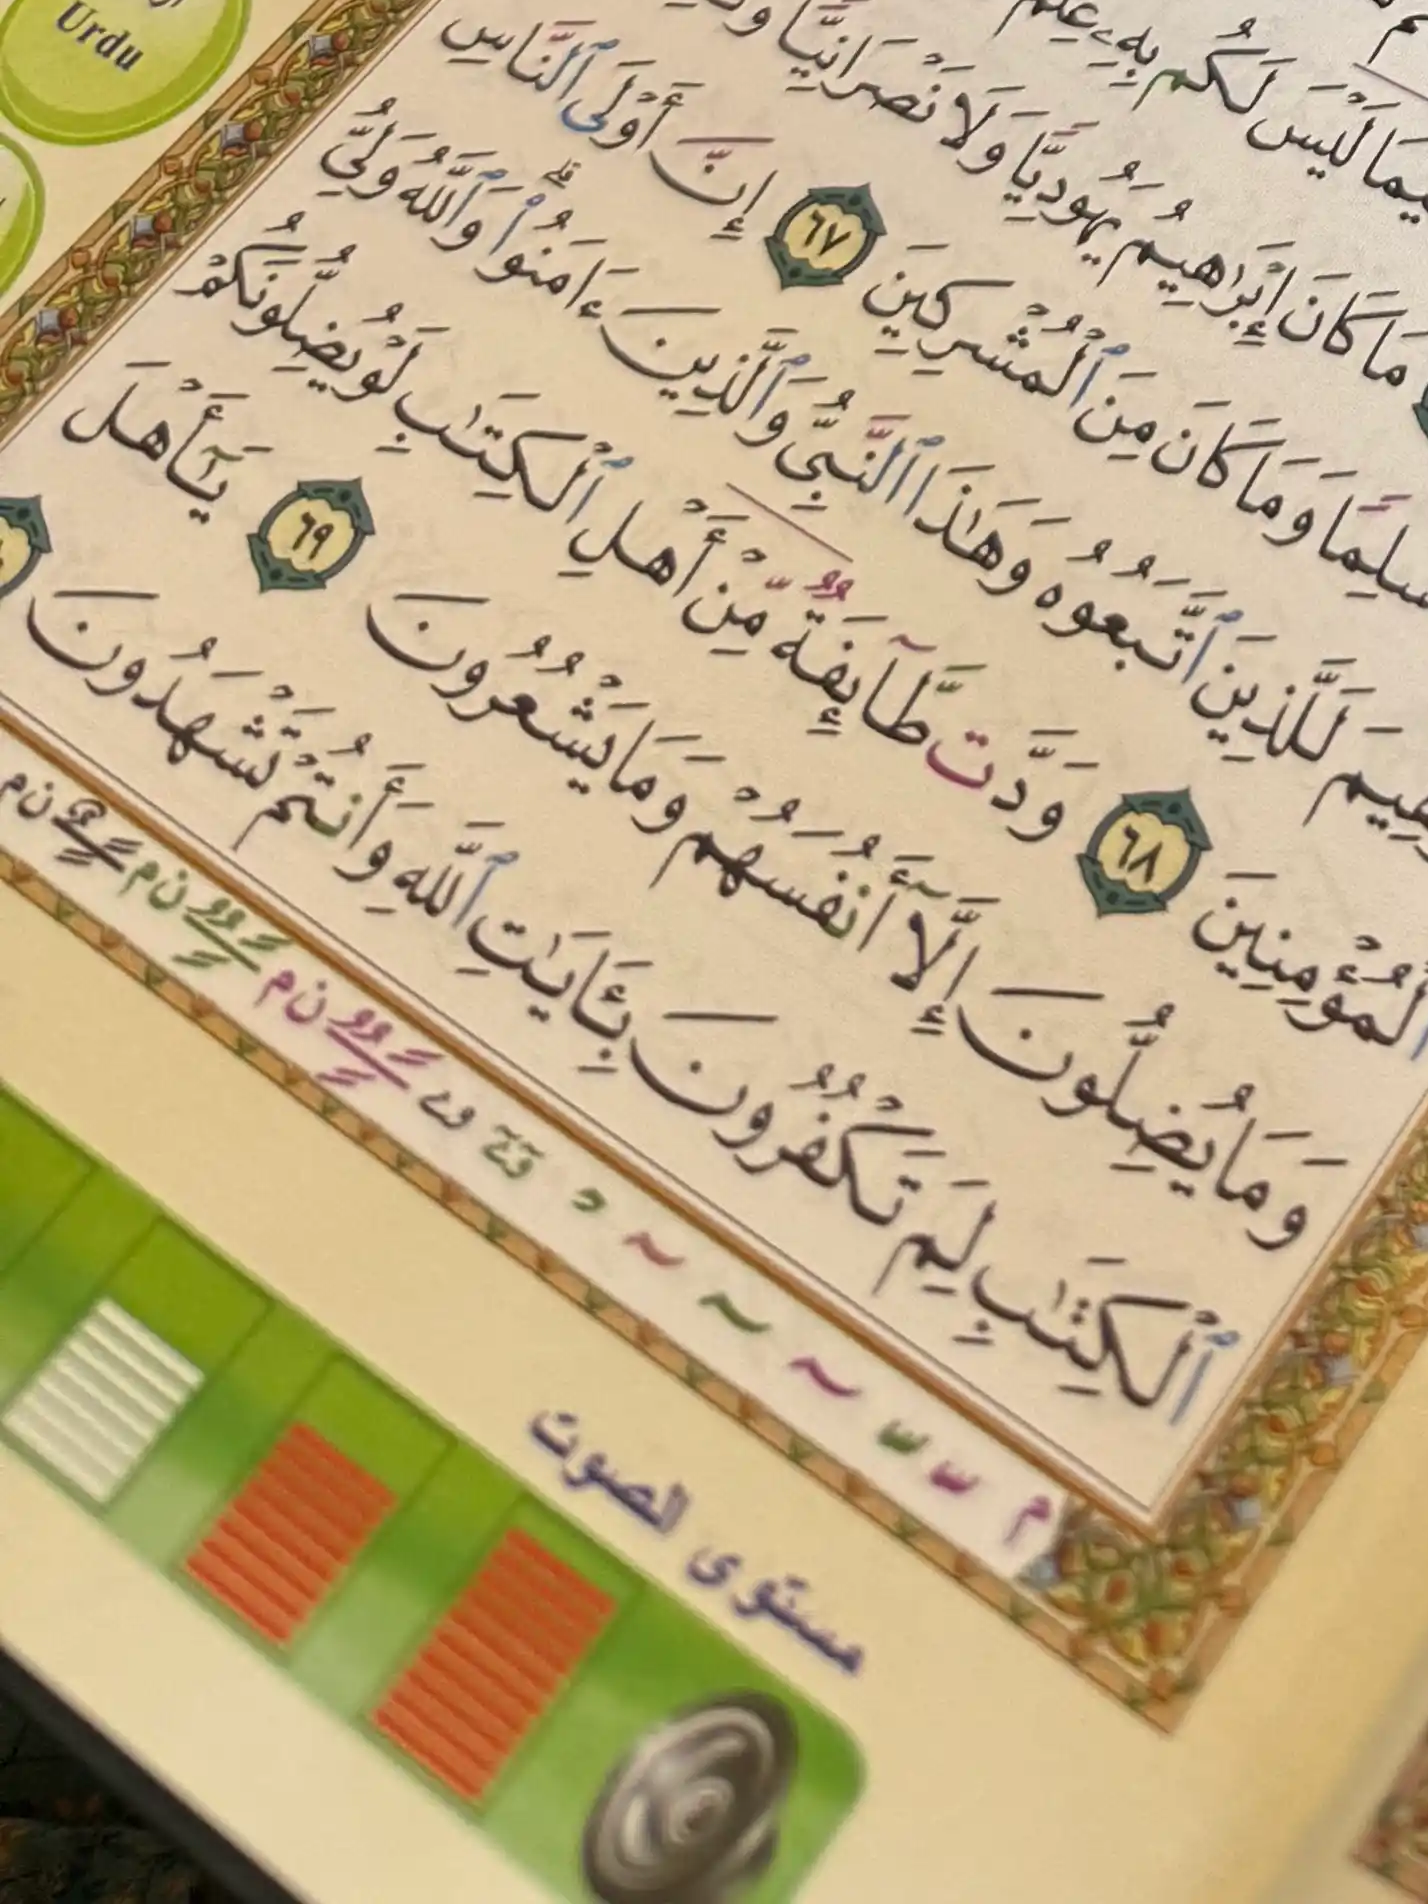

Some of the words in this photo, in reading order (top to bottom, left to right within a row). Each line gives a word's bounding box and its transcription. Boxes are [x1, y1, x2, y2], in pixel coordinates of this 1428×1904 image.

[55, 0, 145, 74] Urdu
[529, 1411, 691, 1534] الصوت
[687, 1547, 865, 1676] مستوى
